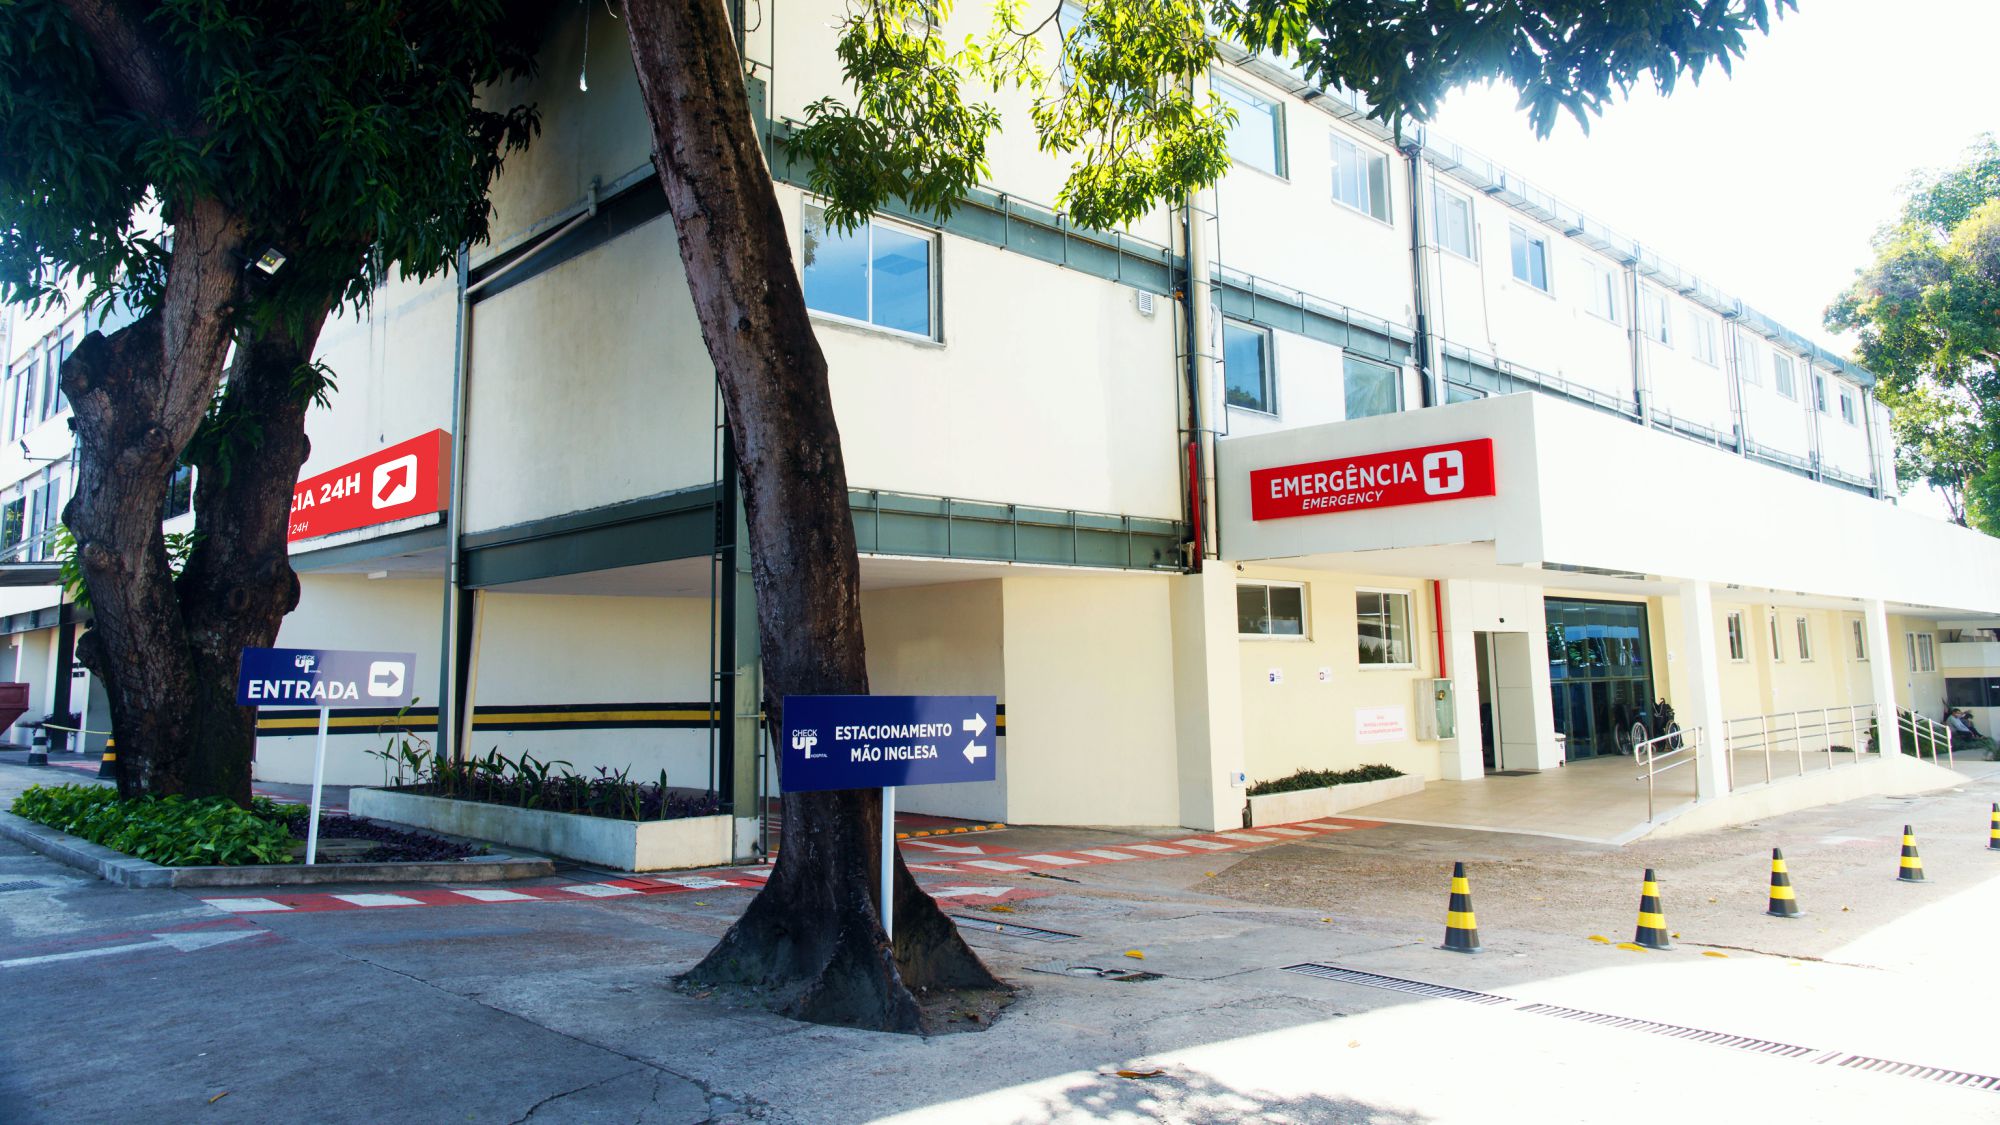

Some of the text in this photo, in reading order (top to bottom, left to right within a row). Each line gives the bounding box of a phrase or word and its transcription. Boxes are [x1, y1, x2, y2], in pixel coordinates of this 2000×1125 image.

[320, 472, 360, 504] 24H
[1270, 461, 1417, 498] EMERGÊNCIA
[1302, 490, 1384, 510] EMERGENCY
[291, 521, 309, 535] 24H
[247, 680, 359, 699] ENTRADA
[792, 729, 818, 737] CHECK
[835, 723, 953, 740] ESTACIONAMENTO
[792, 736, 818, 759] UP
[850, 744, 938, 762] MÃO INGLESA
